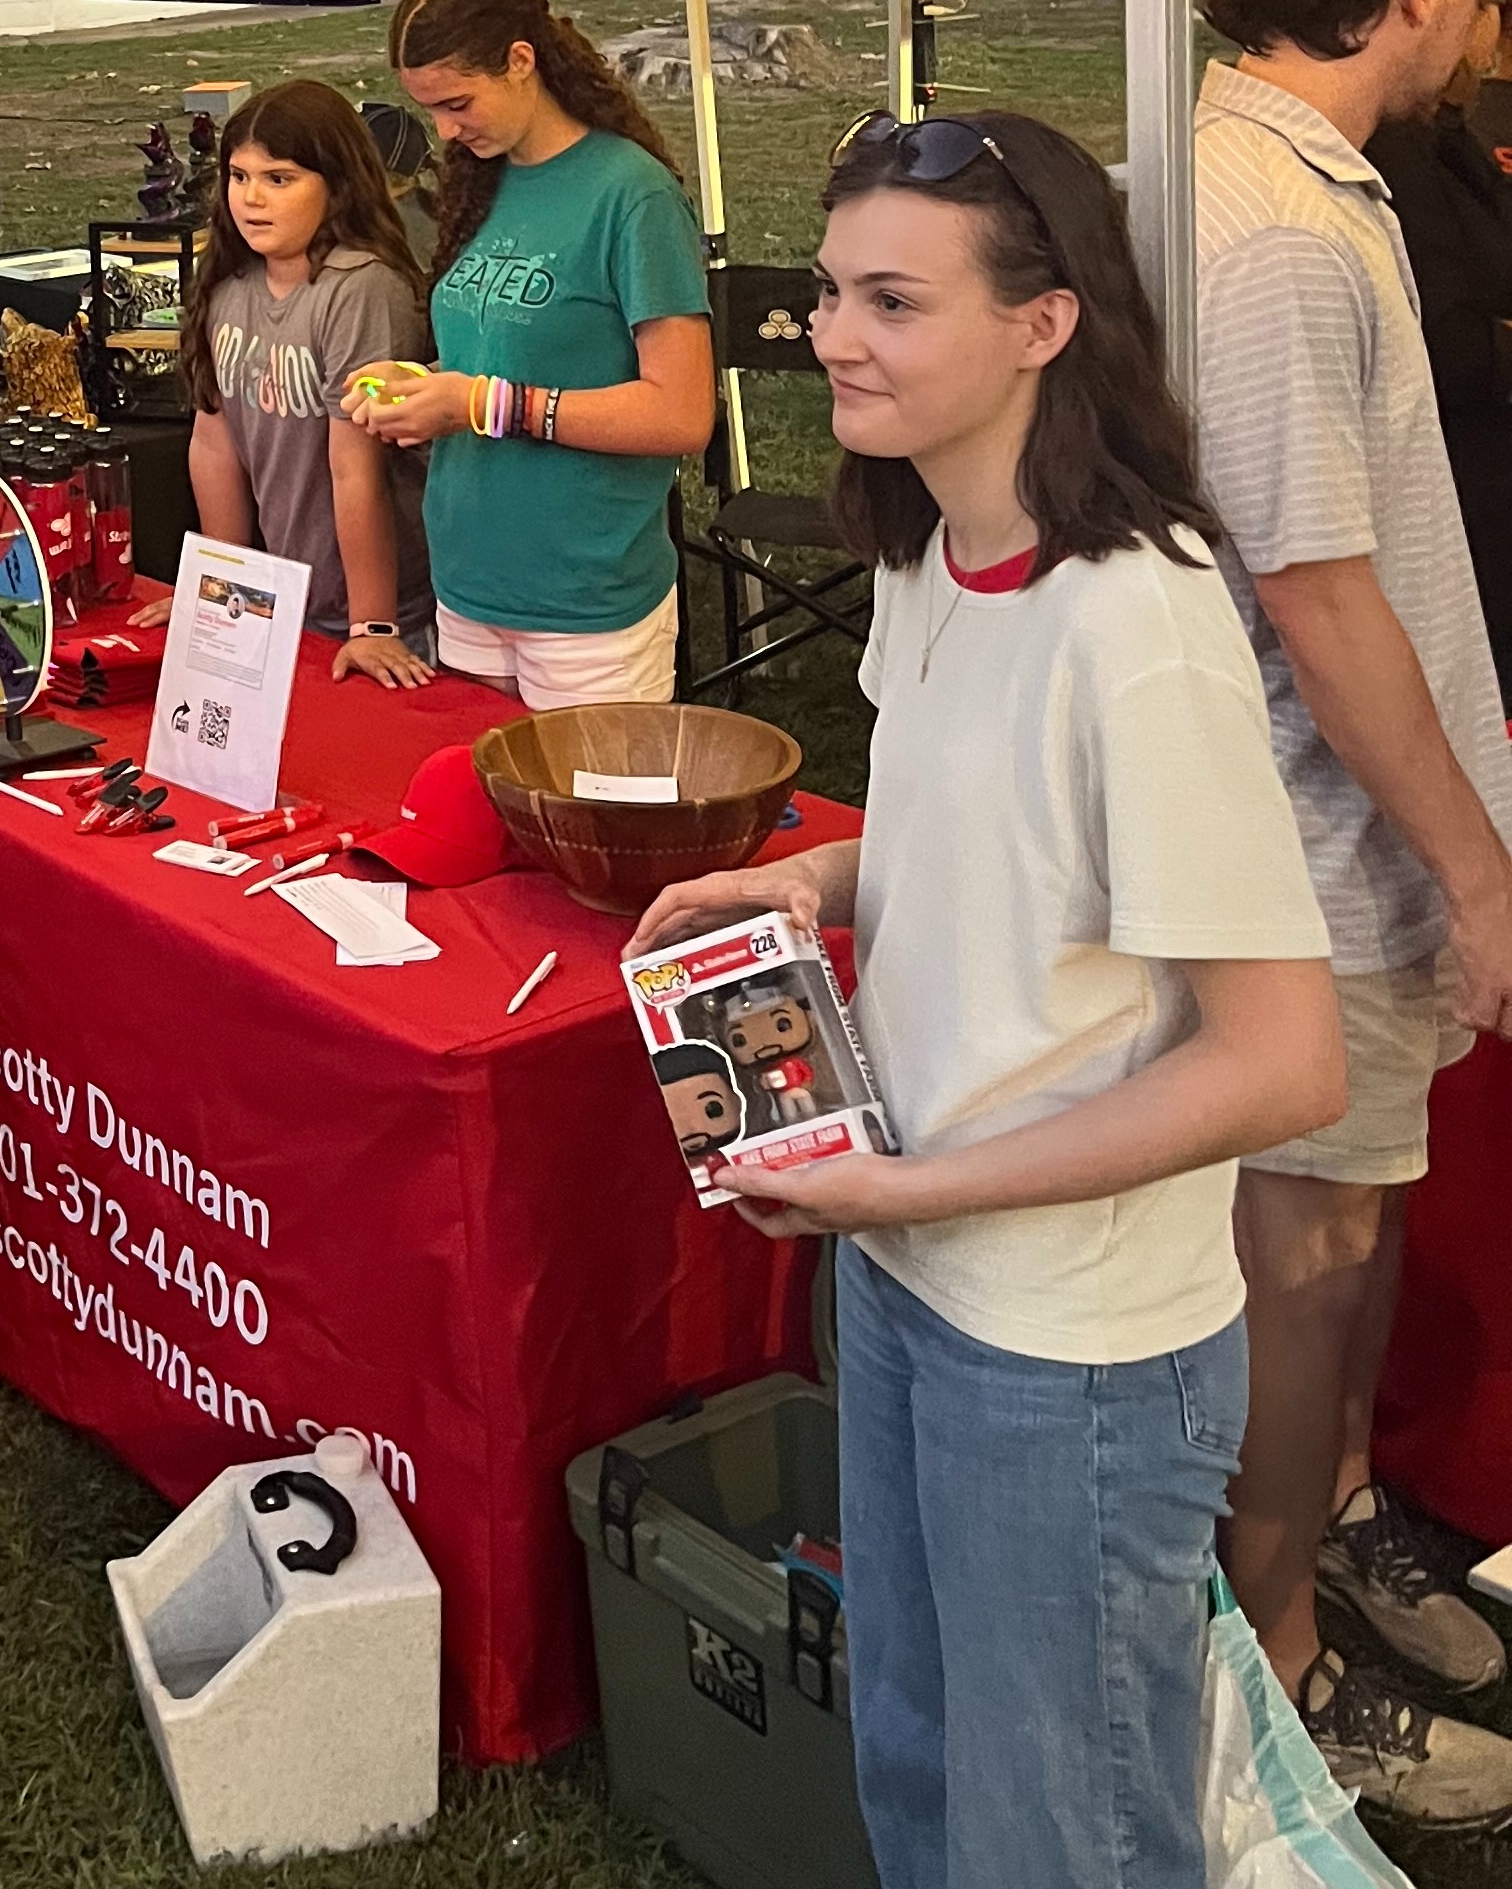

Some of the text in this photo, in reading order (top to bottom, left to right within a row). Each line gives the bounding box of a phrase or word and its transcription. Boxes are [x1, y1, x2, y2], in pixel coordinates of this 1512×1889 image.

[445, 245, 556, 319] EATED
[751, 933, 778, 955] 228
[632, 961, 686, 999] POP!
[87, 1082, 271, 1249] Dunnam
